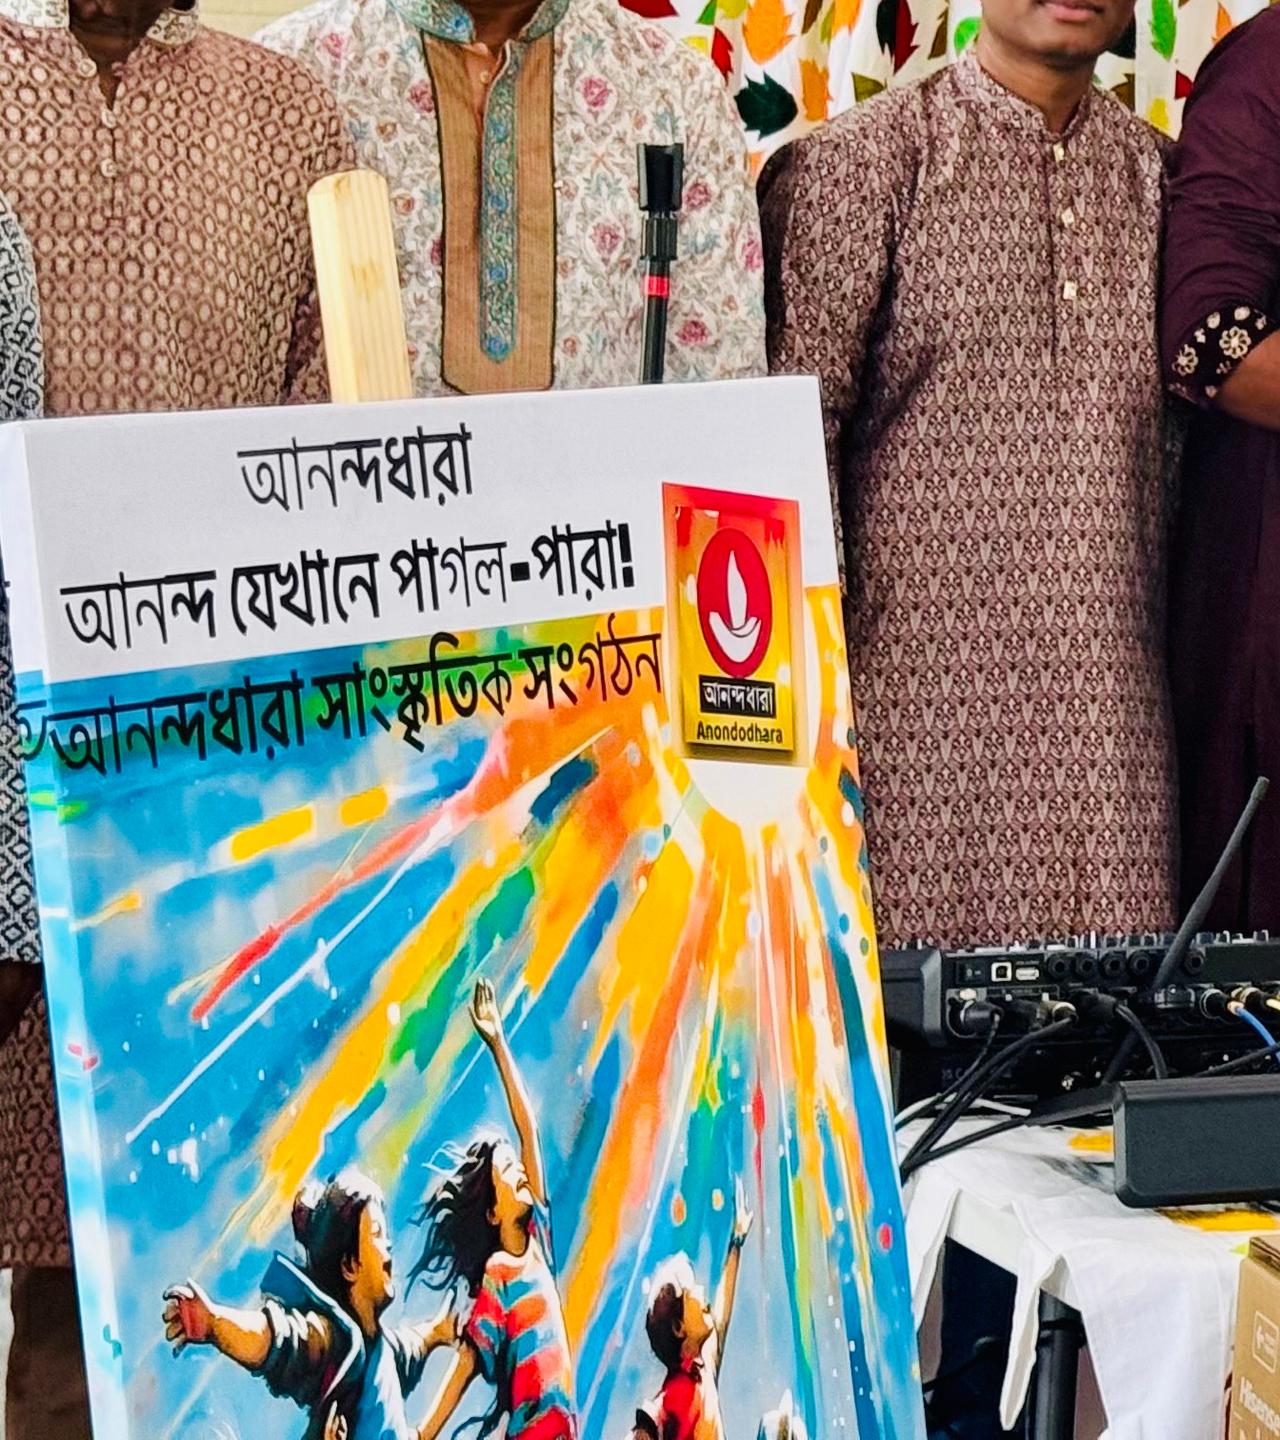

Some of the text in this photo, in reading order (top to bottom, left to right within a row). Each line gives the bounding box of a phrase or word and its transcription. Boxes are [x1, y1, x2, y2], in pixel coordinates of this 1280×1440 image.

[237, 422, 473, 512] আনন্দধারা
[60, 571, 217, 651] আনন্দ
[230, 548, 380, 636] যেখানে
[47, 612, 662, 776] আনন্দধারা সাংস্কৃতিক সংগঠন
[696, 720, 783, 743] Anondodhara
[702, 682, 774, 715] আনন্দধারা
